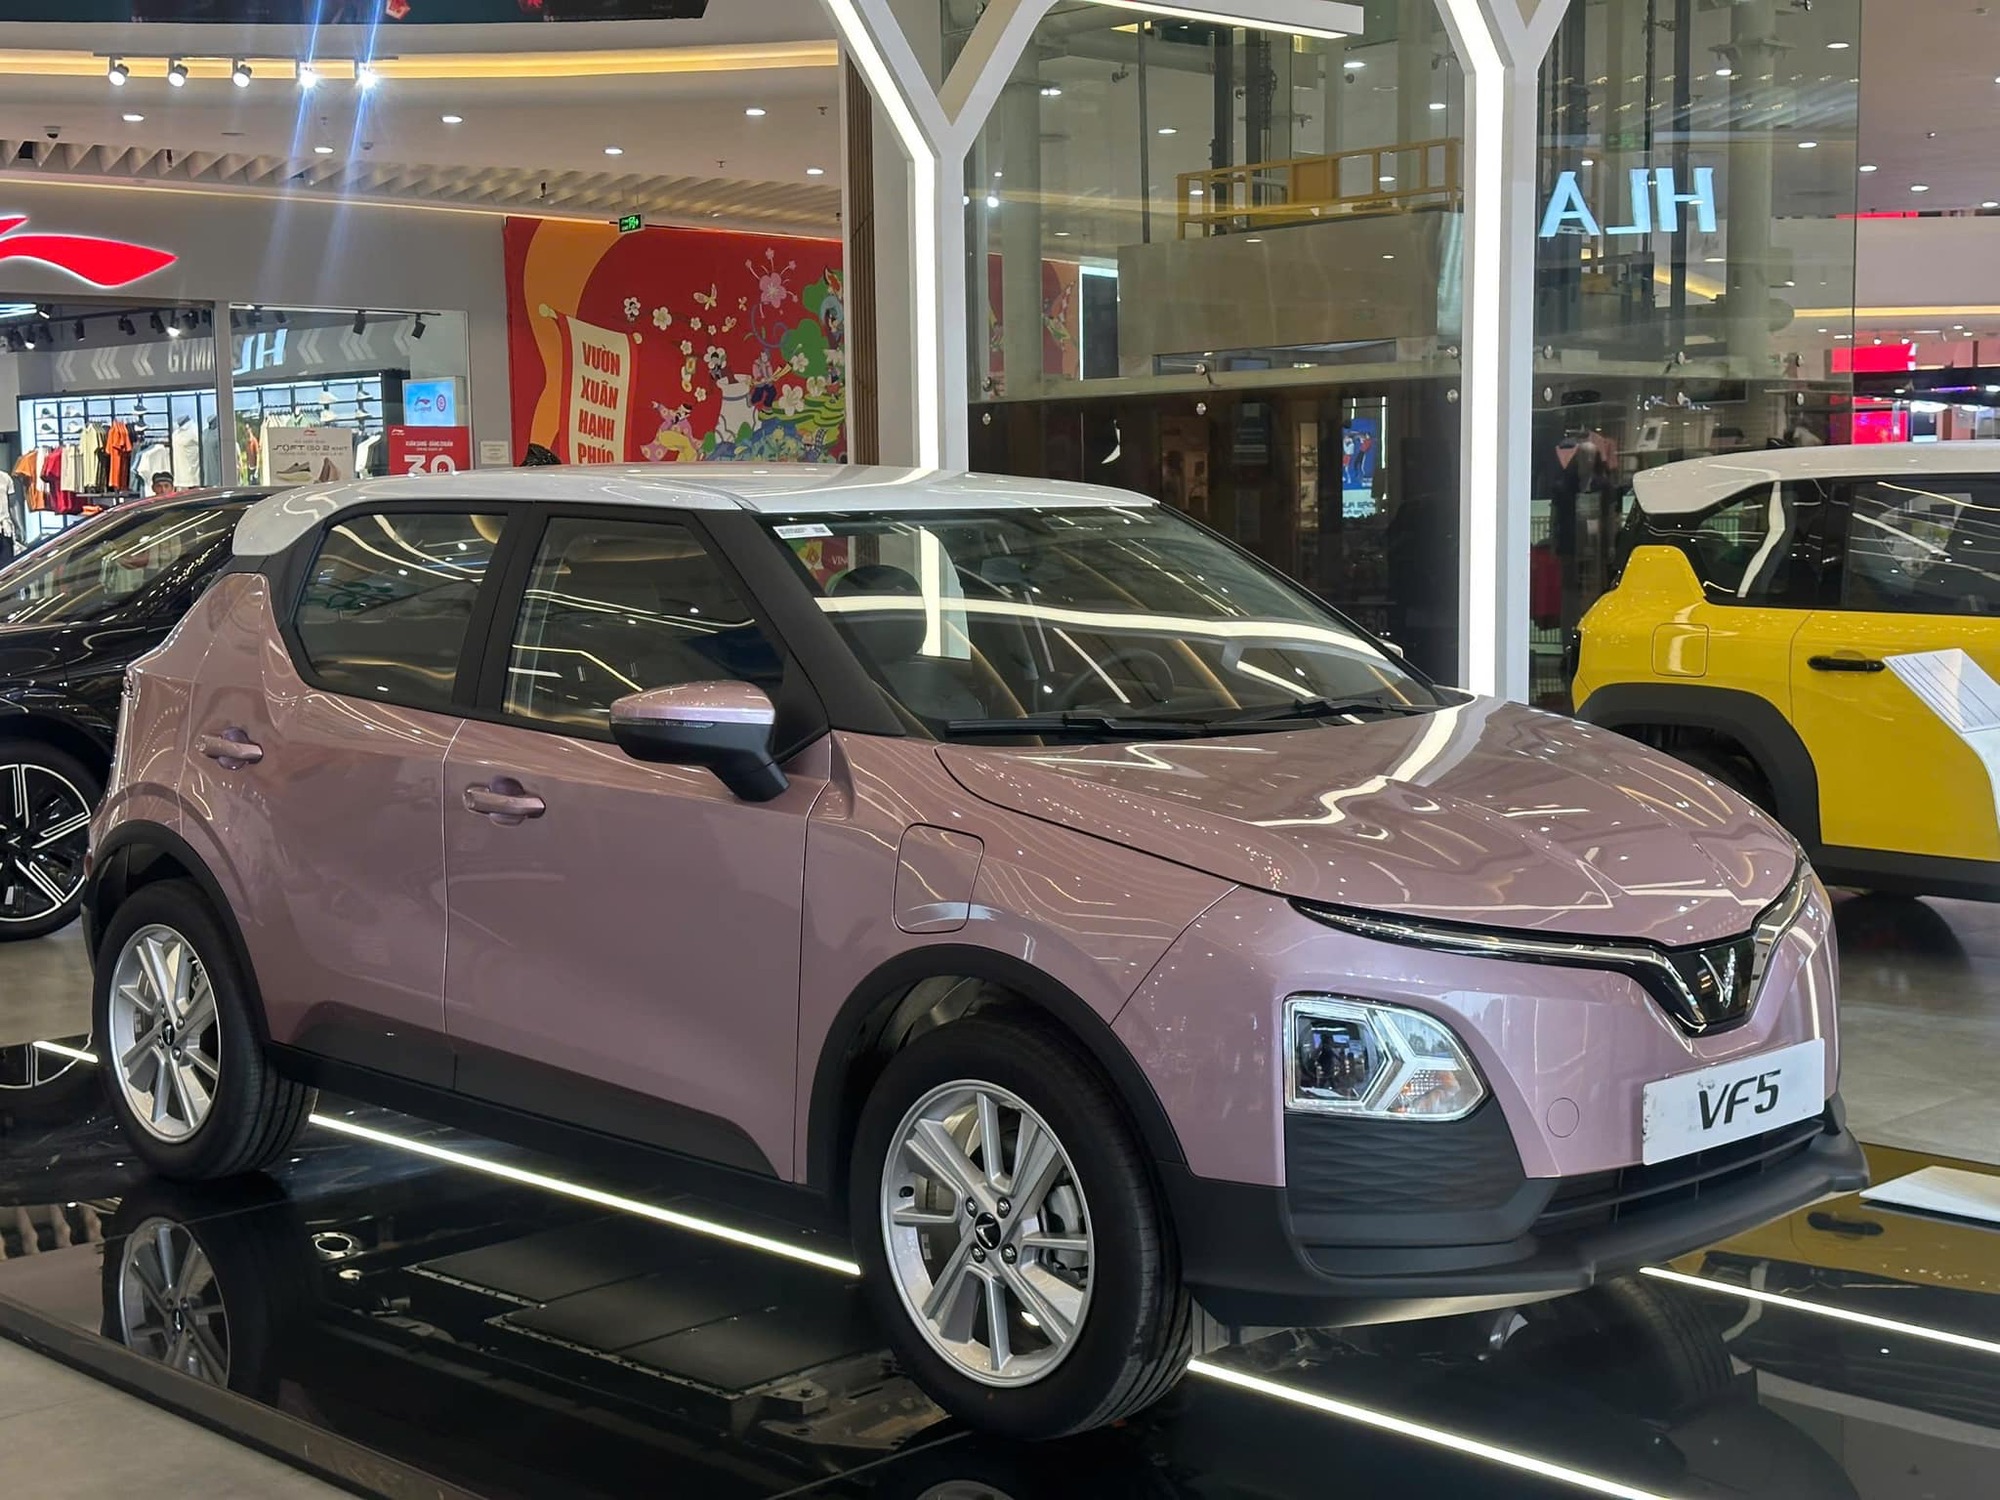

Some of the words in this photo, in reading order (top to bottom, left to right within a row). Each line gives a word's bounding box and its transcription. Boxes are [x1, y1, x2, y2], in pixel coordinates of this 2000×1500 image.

[582, 342, 621, 377] VƯỜN
[580, 374, 619, 410] XUÂN
[577, 408, 615, 441] HẠNH
[1698, 1069, 1782, 1130] VF5
